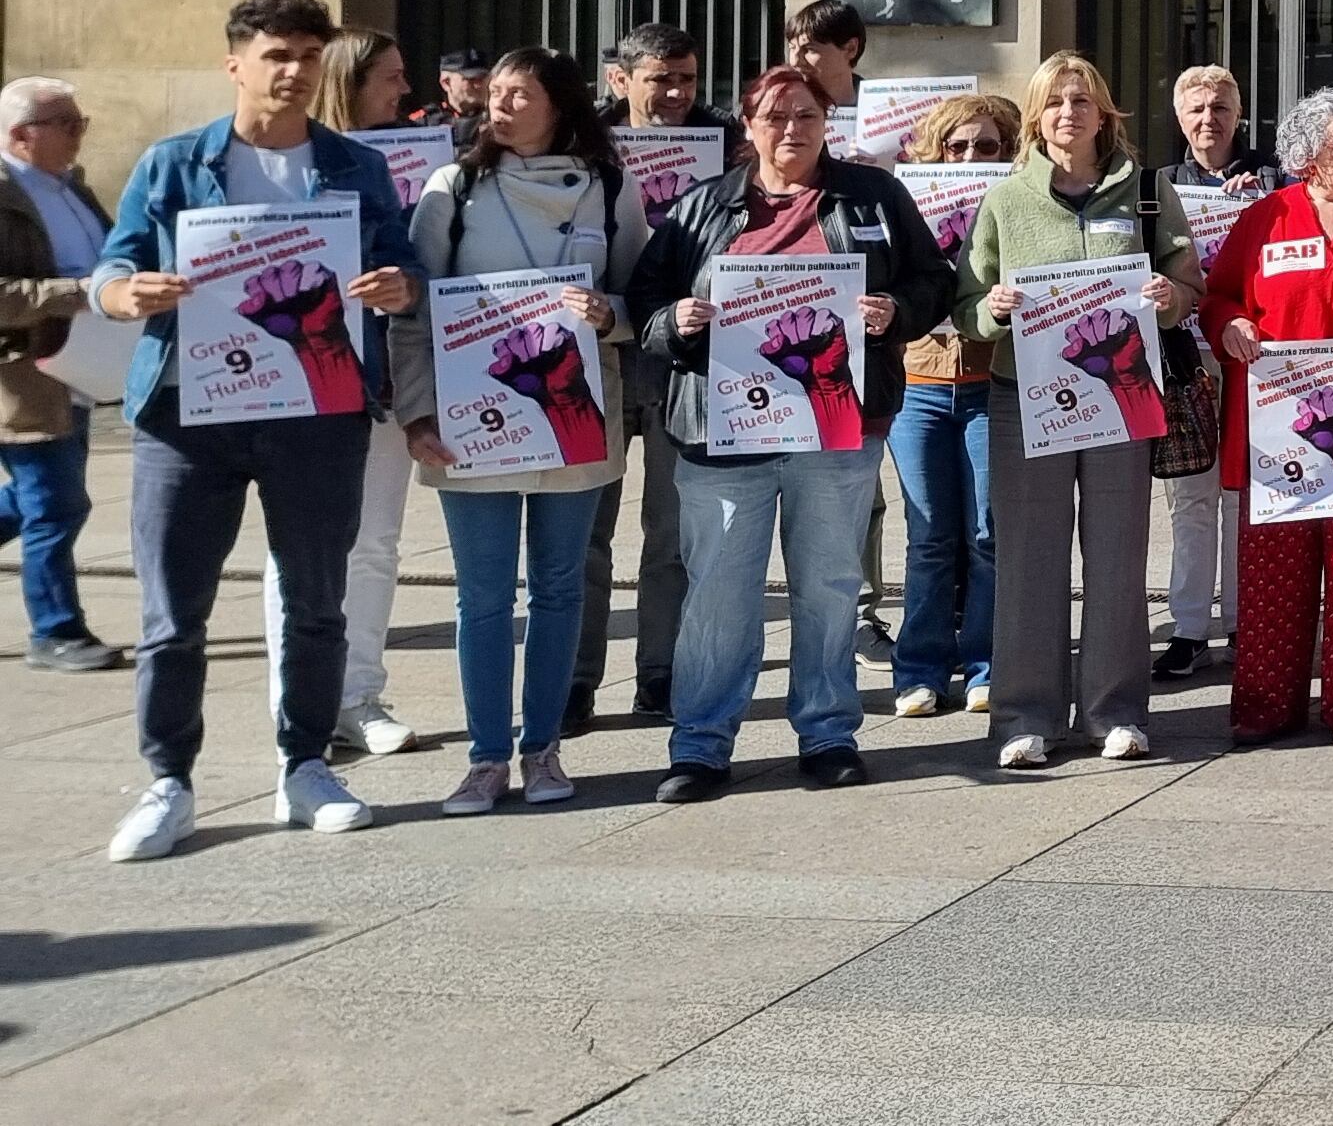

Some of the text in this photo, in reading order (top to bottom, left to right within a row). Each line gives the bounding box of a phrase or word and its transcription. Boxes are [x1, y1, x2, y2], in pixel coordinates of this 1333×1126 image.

[1267, 244, 1319, 263] LAB
[720, 263, 769, 272] Kalitatezko
[771, 262, 805, 273] zerbitzu
[500, 290, 548, 314] nuestras
[720, 287, 836, 327] condiciones laborales
[721, 295, 759, 312] Mejora
[761, 290, 774, 301] de
[776, 276, 823, 298] nuestras
[1021, 277, 1113, 322] Mejora de nuestras
[1022, 287, 1127, 337] condiciones laborales
[443, 300, 564, 352] condiciones laborales
[190, 332, 258, 361] Greba
[225, 350, 252, 373] 9
[204, 369, 282, 401] Huelga
[718, 370, 777, 396] Greba
[1027, 373, 1081, 400] Greba
[1256, 382, 1313, 407] condiciones
[1257, 377, 1290, 392] Mejora
[1292, 372, 1303, 381] de
[448, 391, 508, 420] Greba
[747, 387, 769, 410] 9
[1056, 389, 1077, 411] 9
[480, 408, 505, 432] 9
[728, 405, 795, 435] Huelga
[1041, 404, 1101, 435] Huelga
[463, 425, 532, 457] Huelga
[1258, 446, 1308, 469] Greba
[1284, 461, 1303, 482] 9
[1268, 478, 1325, 504] Huelga
